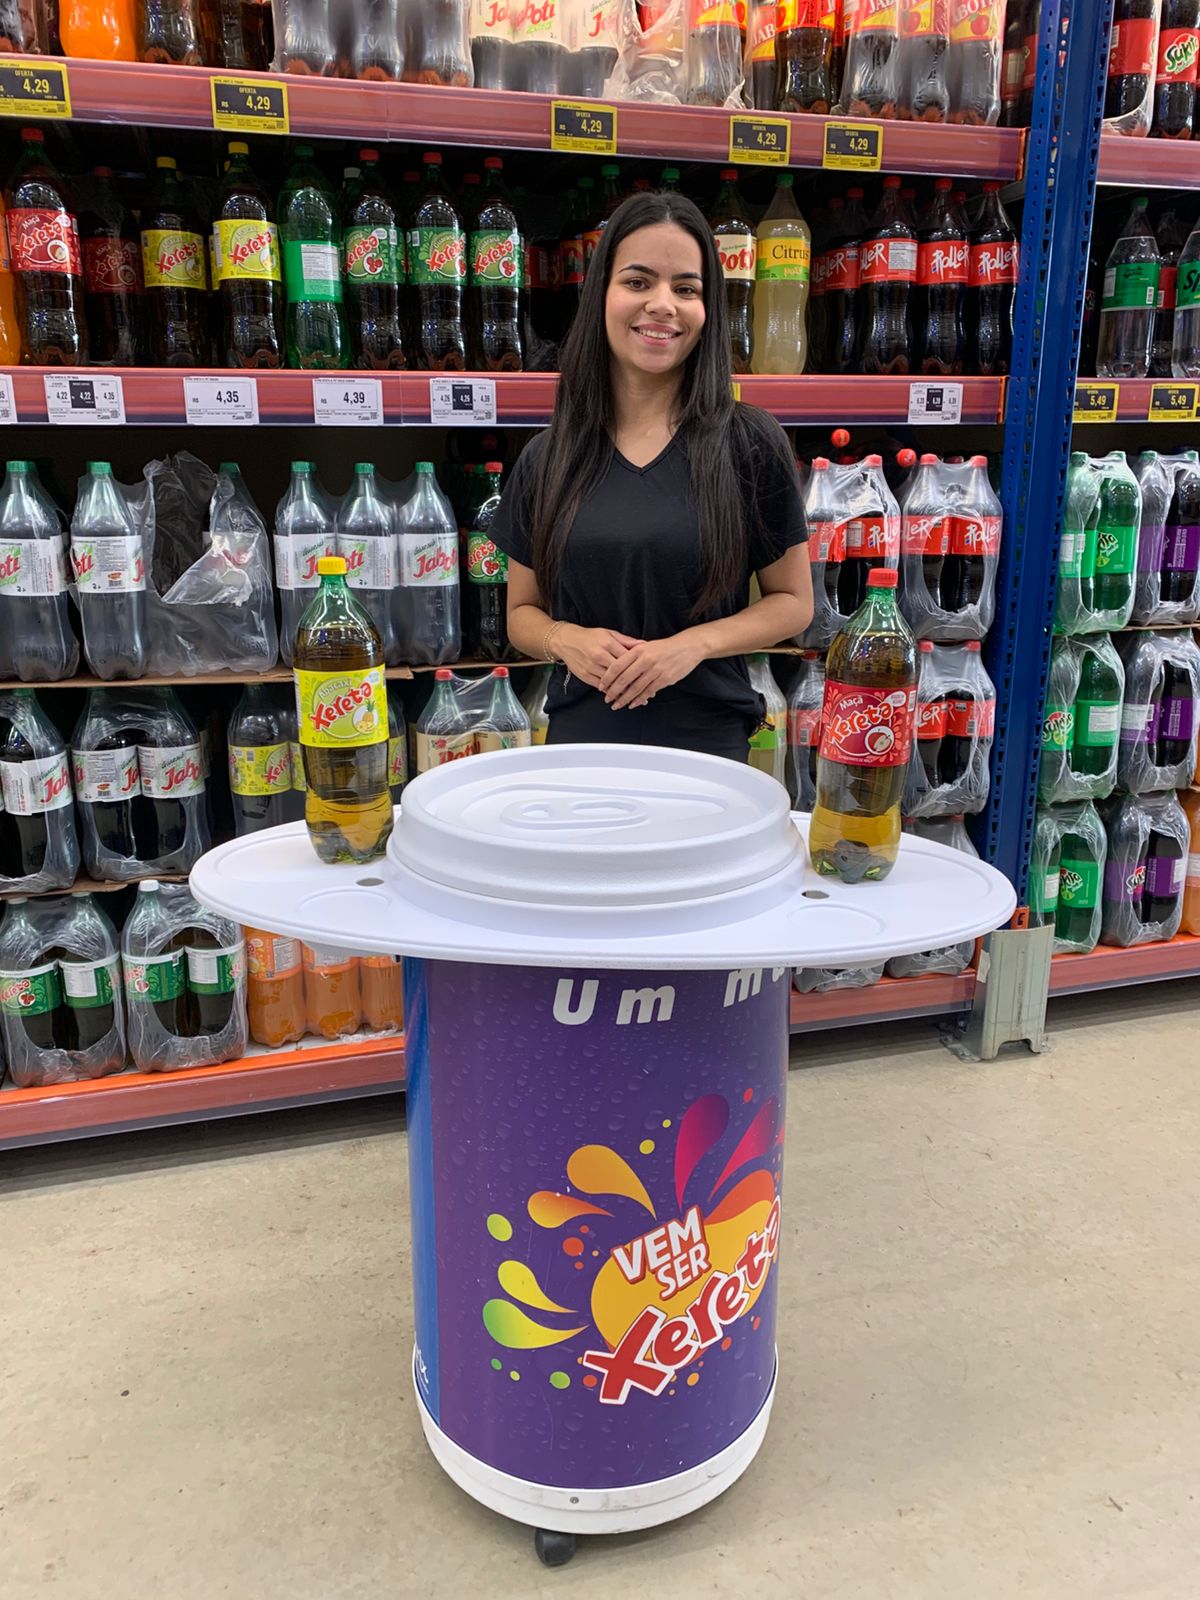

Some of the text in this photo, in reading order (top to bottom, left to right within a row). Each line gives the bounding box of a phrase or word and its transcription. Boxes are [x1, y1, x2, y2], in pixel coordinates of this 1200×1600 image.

[23, 78, 50, 95] 4,29
[245, 95, 271, 111] 4,29
[581, 119, 602, 134] 4,29
[757, 132, 777, 146] 4,29
[849, 138, 869, 151] 4,29
[230, 230, 272, 266] Xereta
[772, 245, 809, 260] Citrus
[156, 241, 199, 275] Xereta
[473, 238, 514, 276] Xereta
[216, 390, 239, 404] 4,35
[343, 391, 365, 405] 4,39
[1090, 395, 1107, 406] 5,49
[1171, 395, 1187, 406] 5,49
[310, 681, 372, 732] Xereta
[840, 694, 864, 712] Maçã
[826, 702, 894, 745] Xereta
[611, 1206, 702, 1284] VEM
[656, 1242, 712, 1301] SER
[582, 1195, 781, 1405] Xereta
